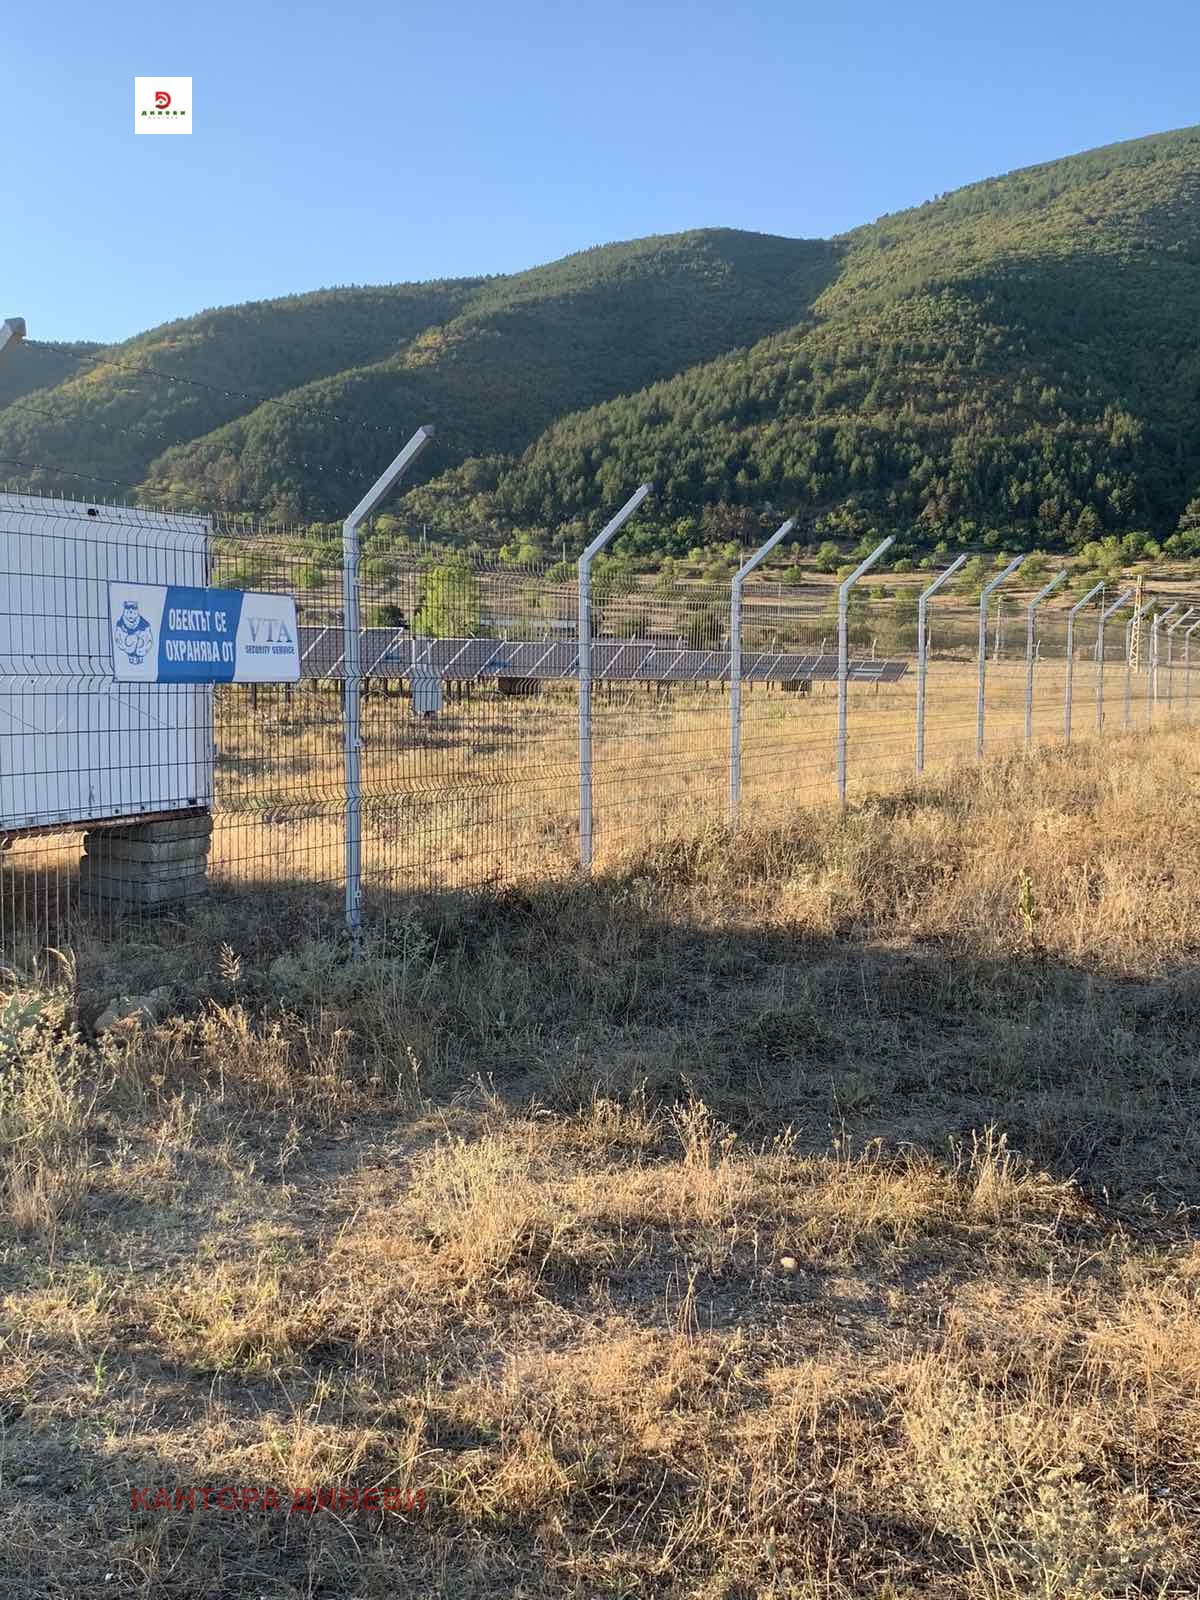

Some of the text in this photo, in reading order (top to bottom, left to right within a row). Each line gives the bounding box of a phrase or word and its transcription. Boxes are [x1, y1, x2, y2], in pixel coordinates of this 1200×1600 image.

[168, 608, 227, 632] ОБЕКТЪТ СЕ
[247, 618, 293, 643] VTA
[165, 640, 234, 662] ОХРАНЯВА ОТ
[245, 645, 271, 654] SECURITY
